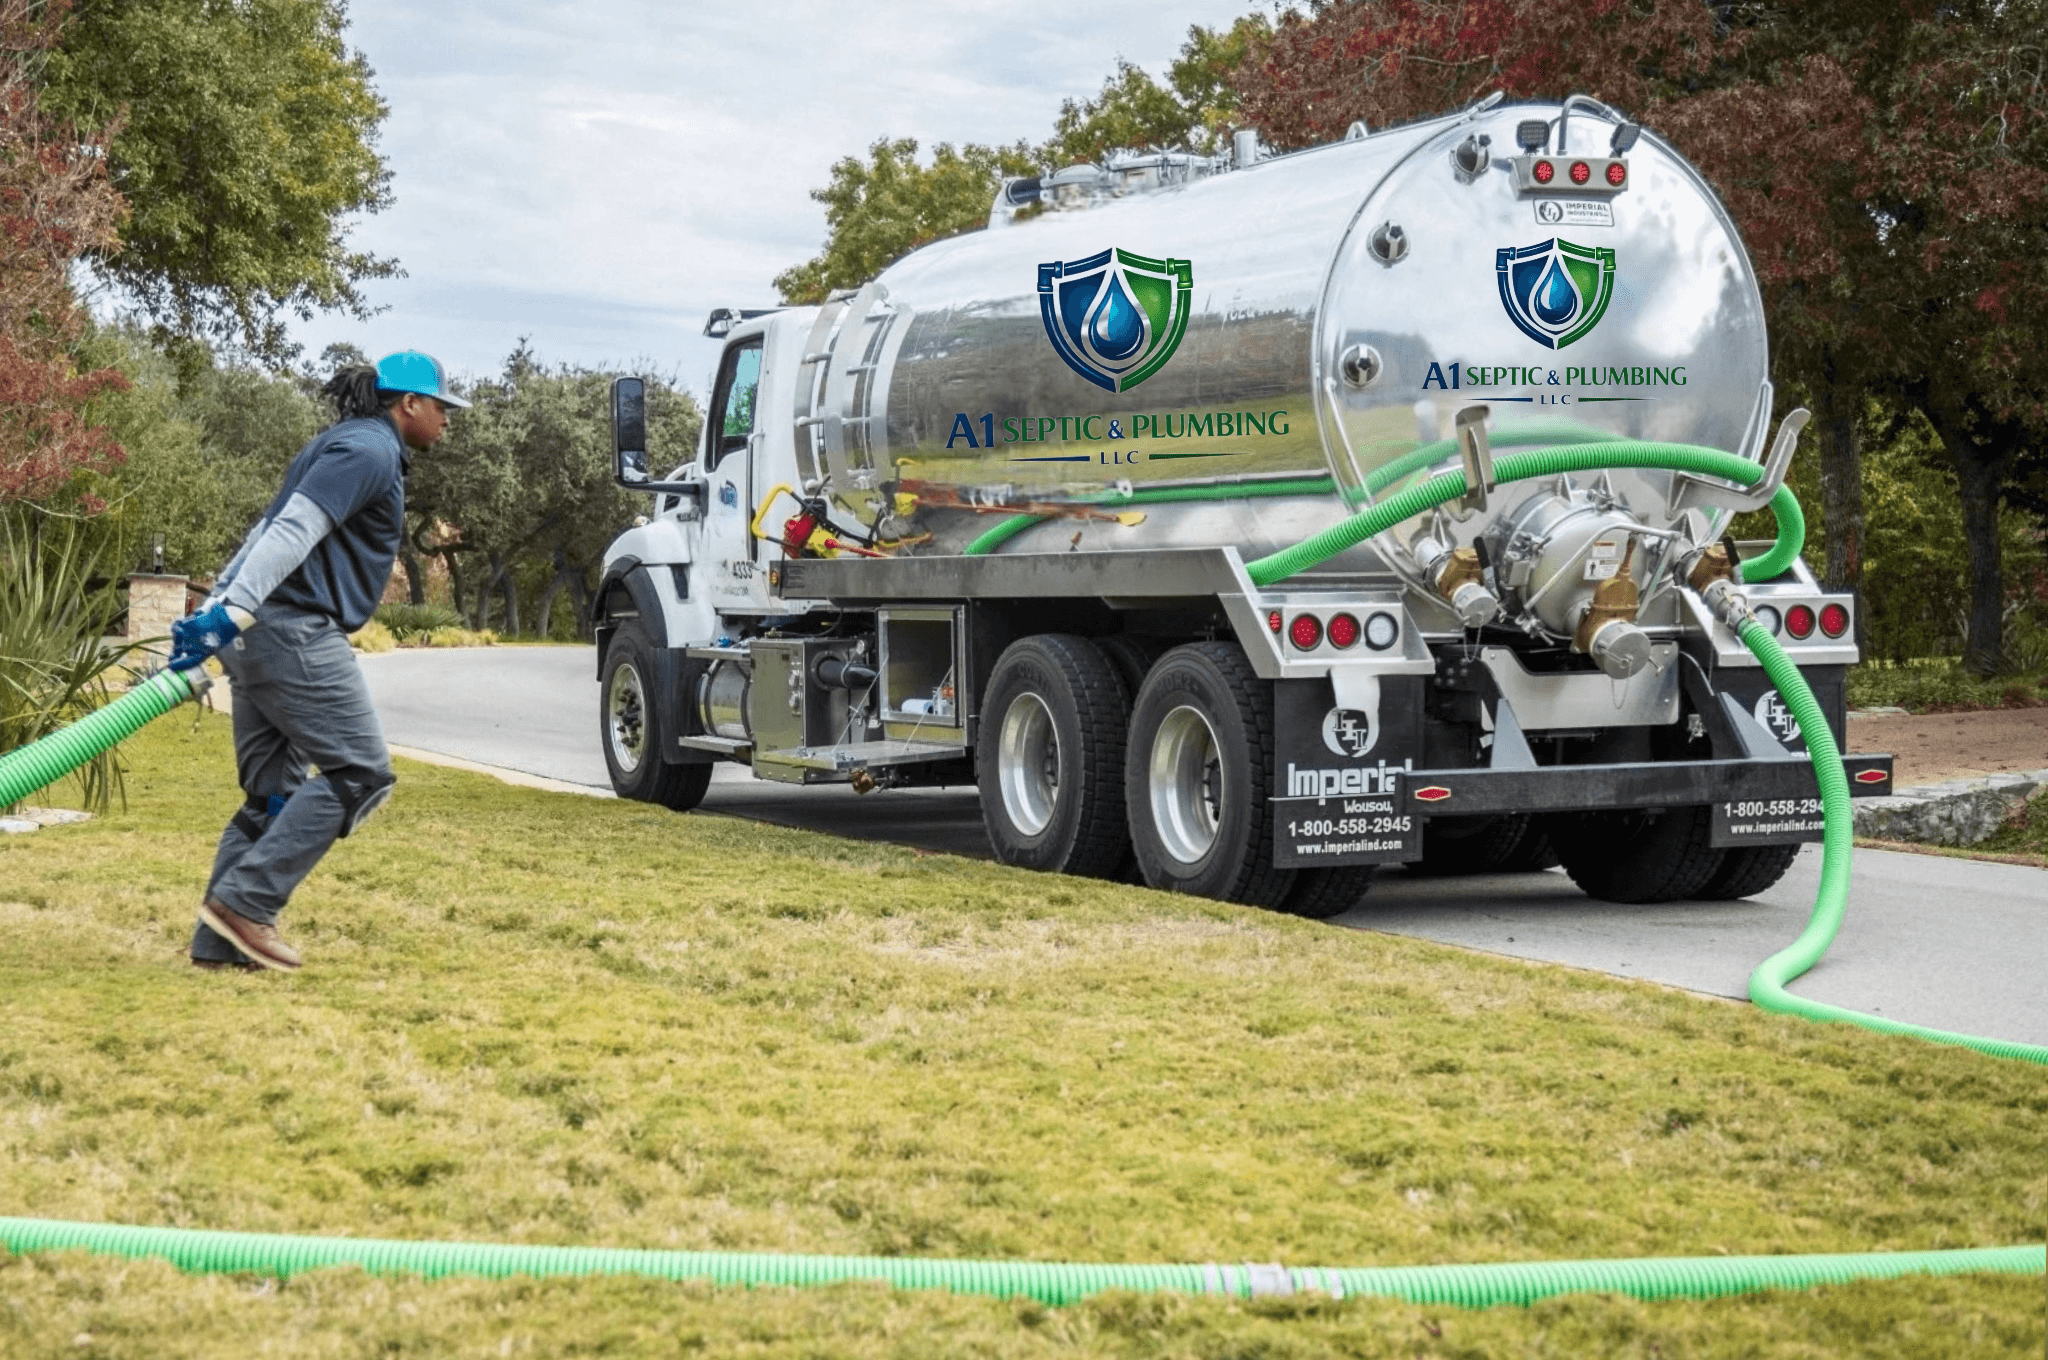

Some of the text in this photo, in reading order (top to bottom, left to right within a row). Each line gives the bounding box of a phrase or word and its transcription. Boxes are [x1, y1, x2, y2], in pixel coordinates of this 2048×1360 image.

[1566, 203, 1608, 211] IMPERIAL
[1421, 362, 1687, 390] A1 SEPTIC & PLUMBING
[1540, 394, 1571, 405] LLC
[946, 410, 1289, 448] A1 SEPTIC & PLUMBING
[1100, 450, 1139, 465] LLC
[1724, 799, 1825, 818] 1-800-558-294
[1287, 816, 1412, 838] 1-800-558-2945
[1296, 839, 1403, 855] www.imperialind.com
